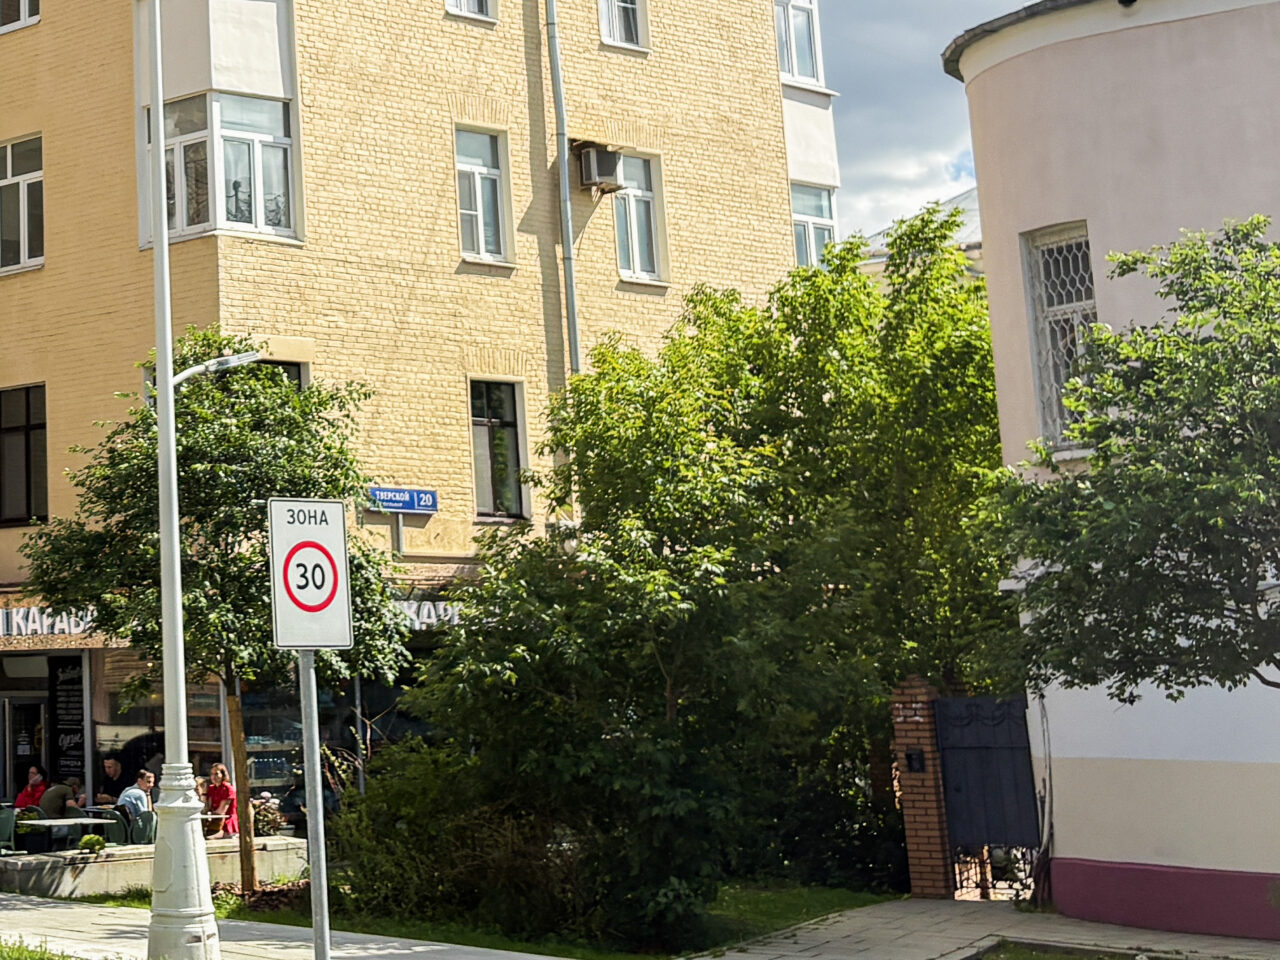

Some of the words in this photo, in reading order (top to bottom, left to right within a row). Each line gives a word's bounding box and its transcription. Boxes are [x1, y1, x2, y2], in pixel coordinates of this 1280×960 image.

[376, 490, 410, 502] ТВЕРСКОЙ
[420, 494, 433, 506] 20
[286, 508, 329, 526] ЗОНА
[295, 562, 326, 591] 30
